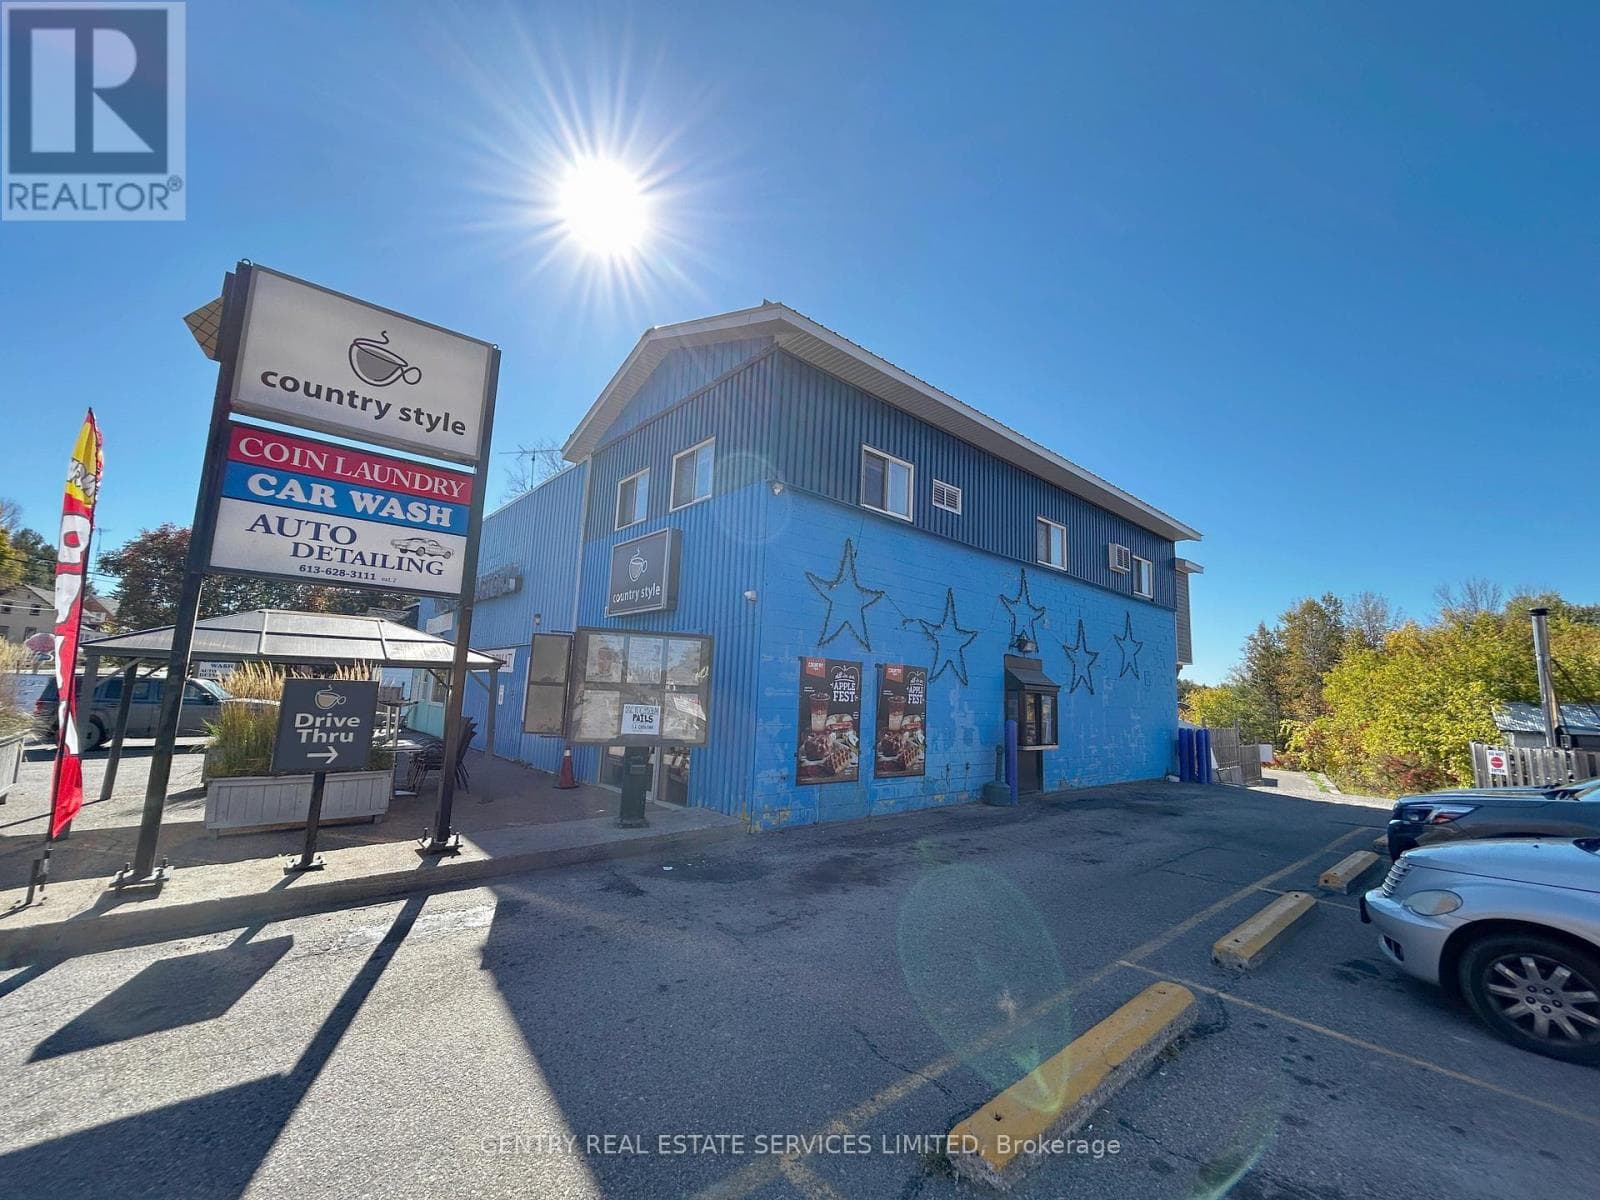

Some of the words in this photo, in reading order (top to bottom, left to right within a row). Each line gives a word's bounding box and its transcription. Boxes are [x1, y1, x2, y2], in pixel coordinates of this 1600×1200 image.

[260, 371, 392, 420] country
[399, 404, 466, 436] style
[239, 437, 328, 471] COIN
[334, 456, 467, 498] LAUNDRY
[247, 473, 337, 508] CAR
[349, 490, 453, 527] WASH
[245, 514, 357, 545] AUTO
[290, 542, 445, 576] DETAILING
[299, 564, 376, 580] 613-628-3111
[612, 589, 640, 602] country
[641, 582, 661, 600] style
[833, 682, 856, 691] APPLE
[832, 690, 856, 702] FEST
[908, 693, 923, 704] FEST
[294, 713, 361, 728] Drive
[632, 713, 654, 723] PAILS
[296, 728, 354, 743] Thru
